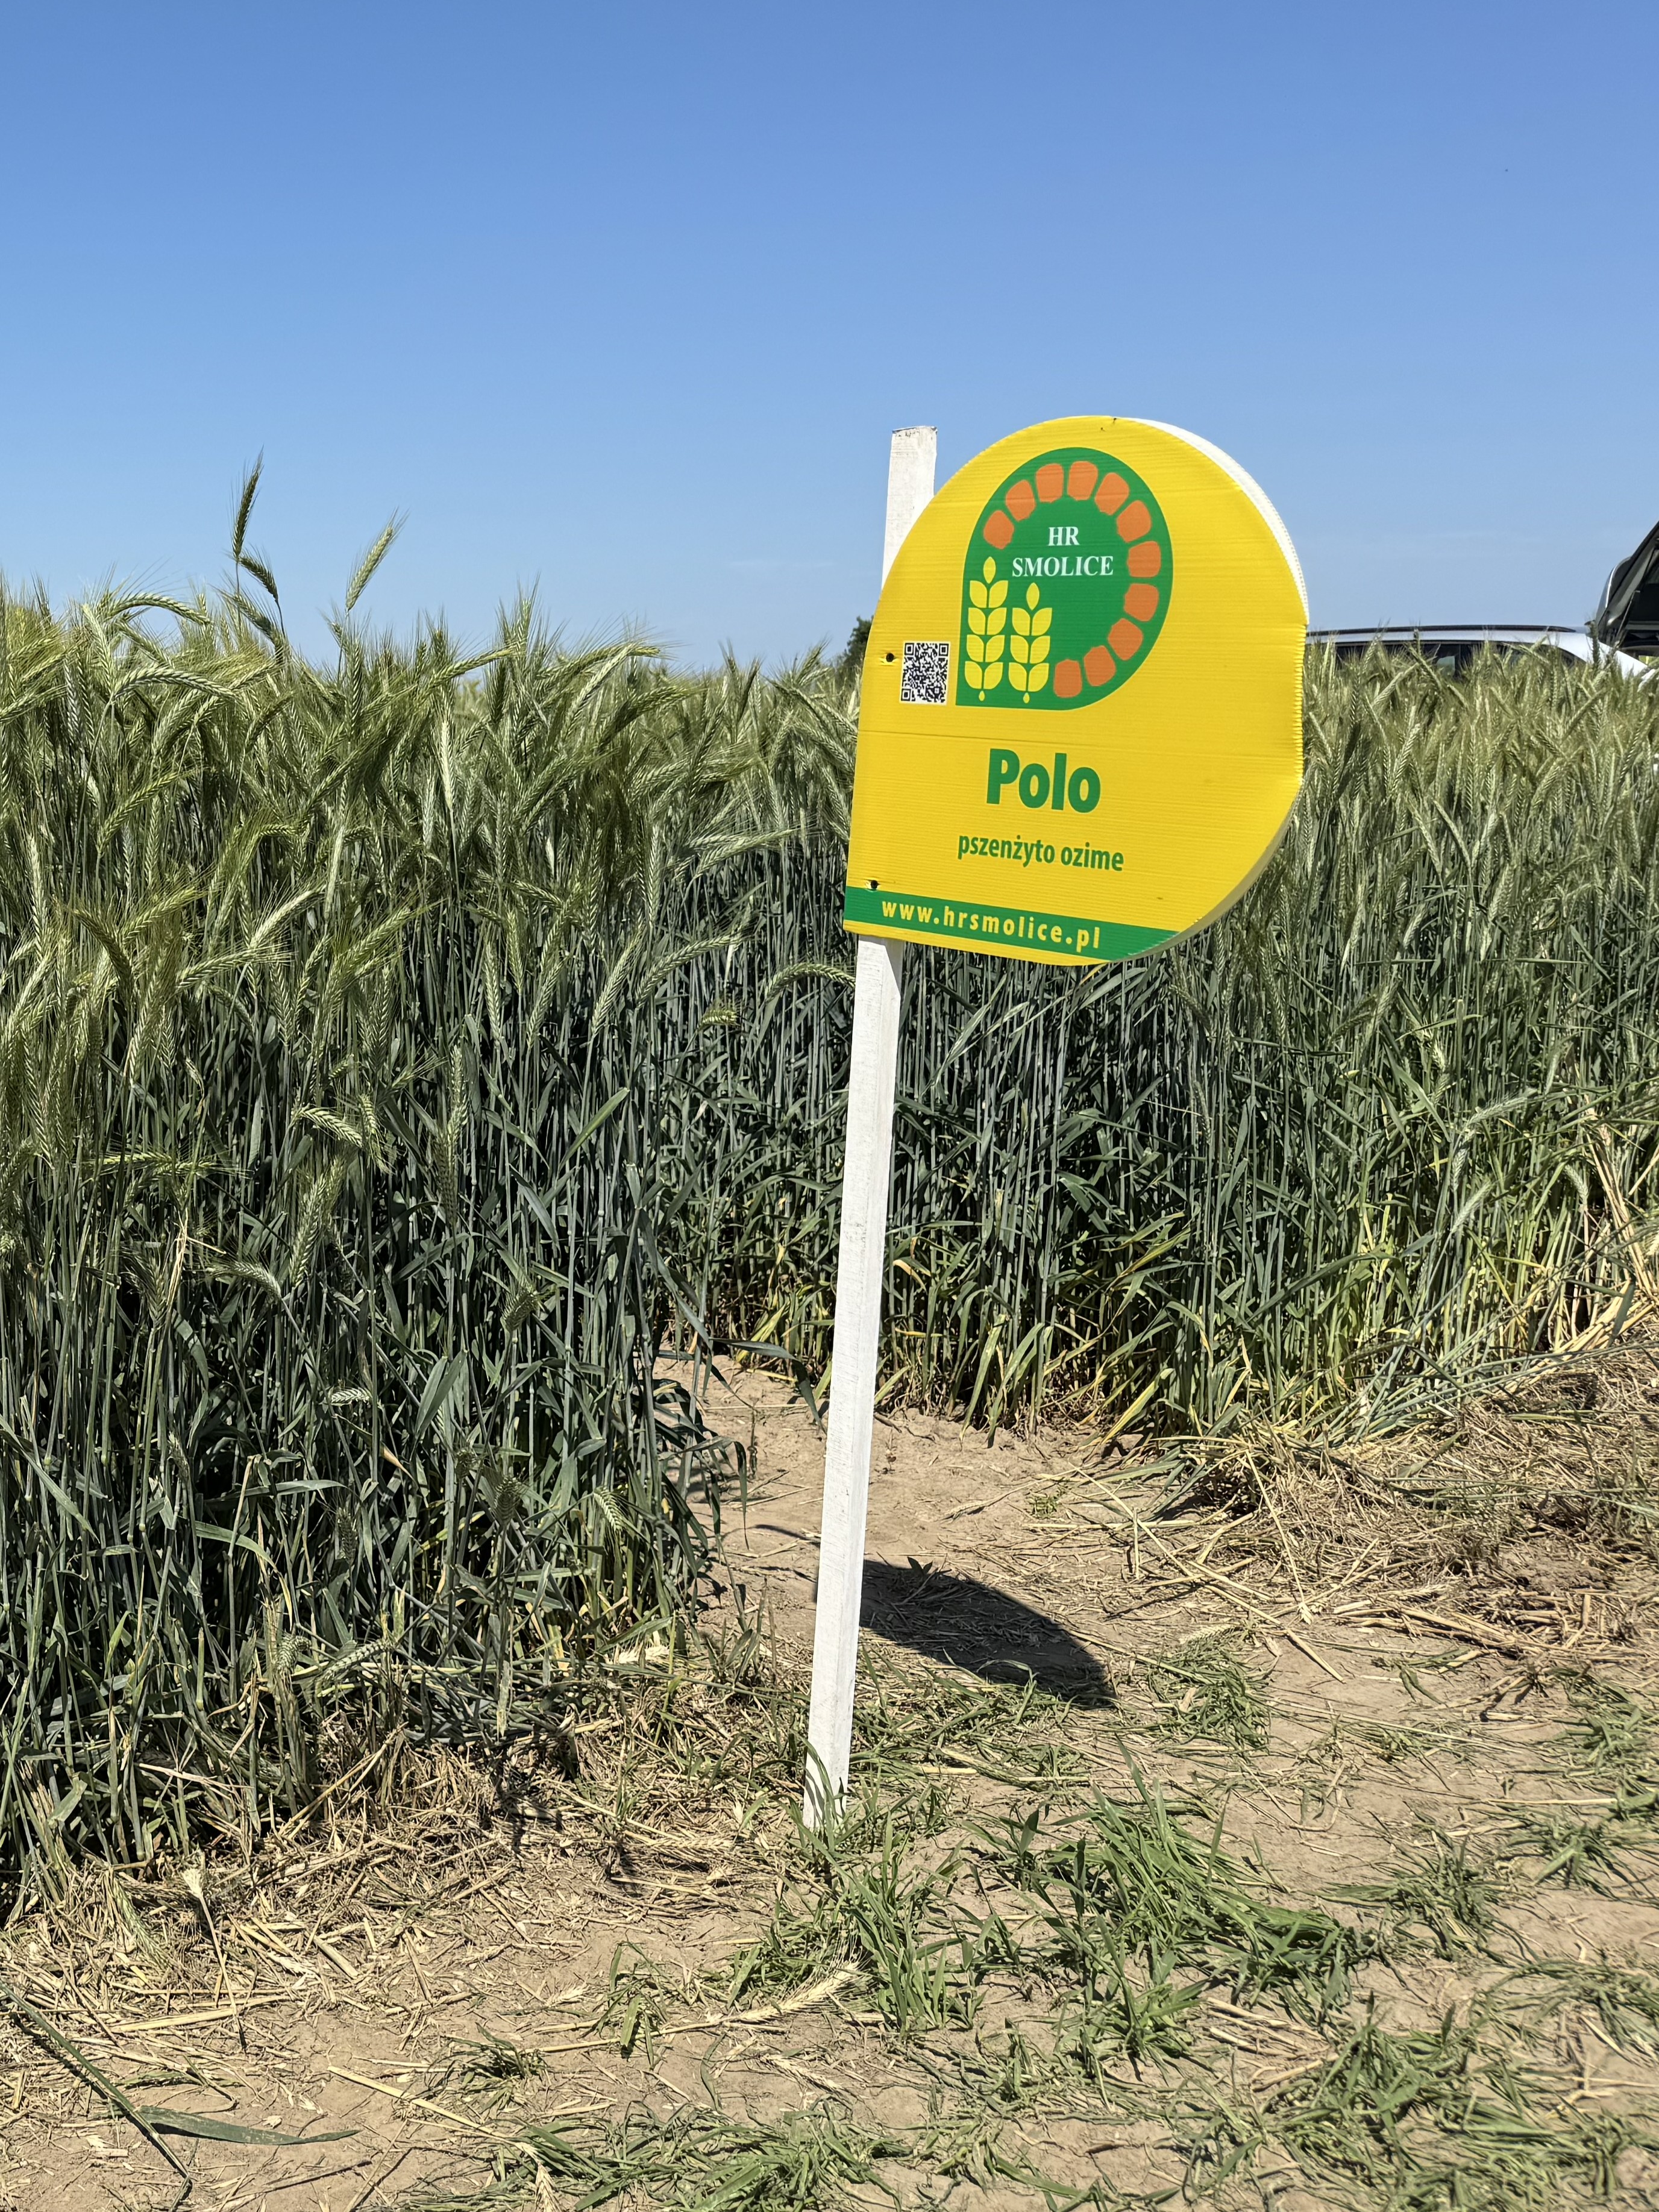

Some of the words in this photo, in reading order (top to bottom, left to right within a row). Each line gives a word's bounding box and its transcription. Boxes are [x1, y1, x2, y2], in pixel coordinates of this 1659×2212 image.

[1047, 526, 1080, 546] HR
[1012, 556, 1114, 577] SMOLICE
[986, 748, 1101, 813] Polo
[958, 835, 1055, 868] pszenżyto
[1061, 842, 1124, 871] ozime
[882, 901, 1100, 952] www.hrsmolice.pl
